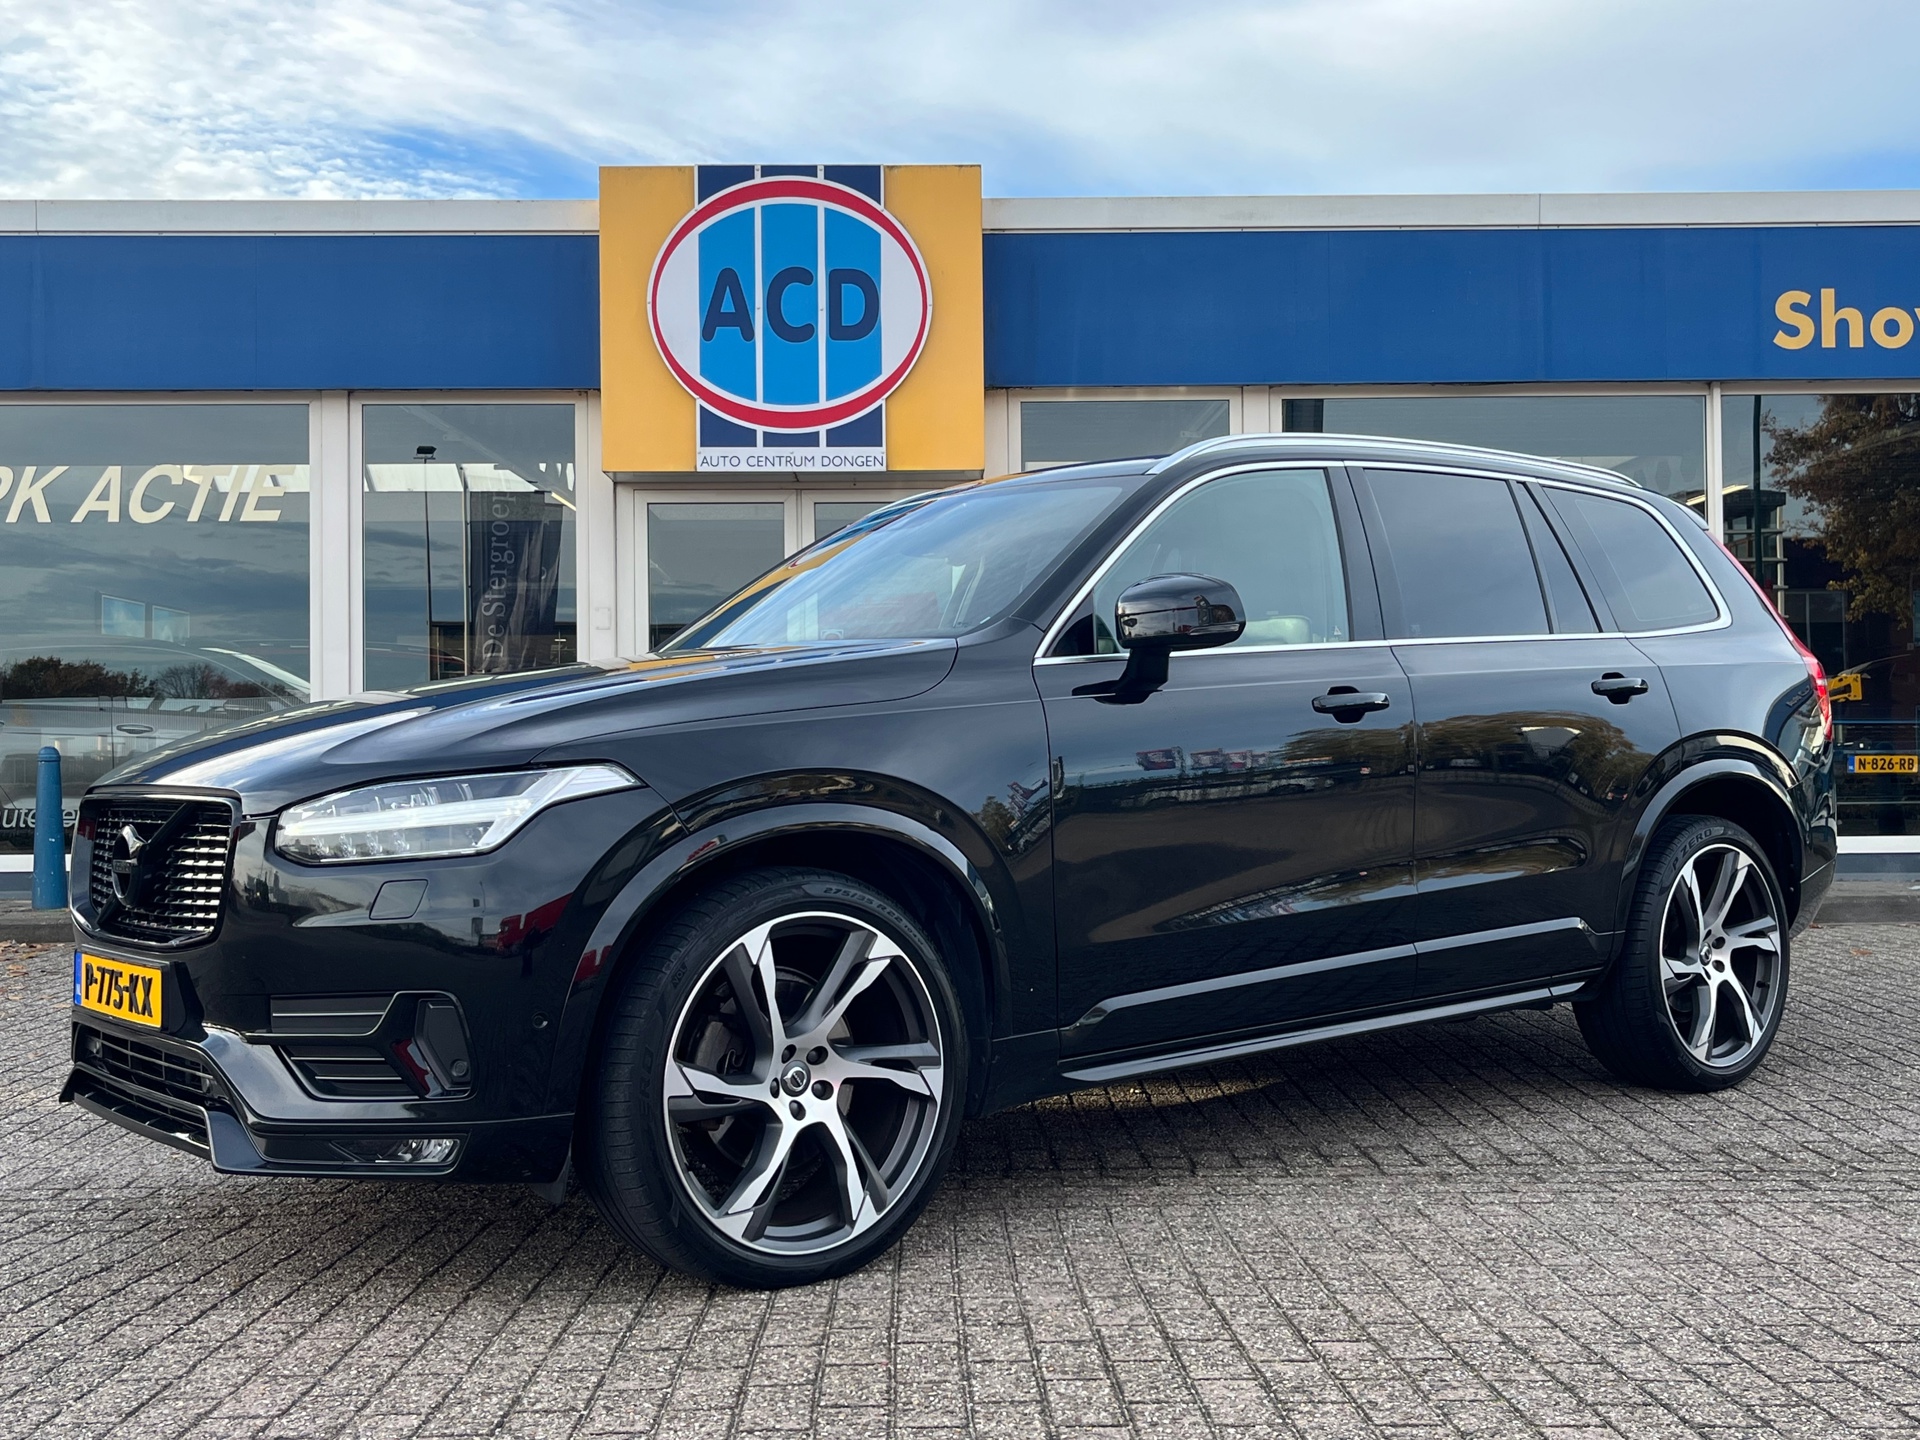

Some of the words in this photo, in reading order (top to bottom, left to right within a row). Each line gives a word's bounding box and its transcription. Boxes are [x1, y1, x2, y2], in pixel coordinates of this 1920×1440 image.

[702, 266, 880, 343] ACD
[1772, 287, 1920, 350] Sho
[700, 455, 741, 467] AUTO
[746, 455, 815, 467] CENTRUM
[821, 455, 884, 467] DONGEN
[70, 464, 297, 524] ACTIE
[482, 623, 504, 659] De
[1858, 757, 1915, 770] N-826-RB
[1680, 828, 1712, 857] ZERO
[84, 962, 153, 1018] P-775-KX
